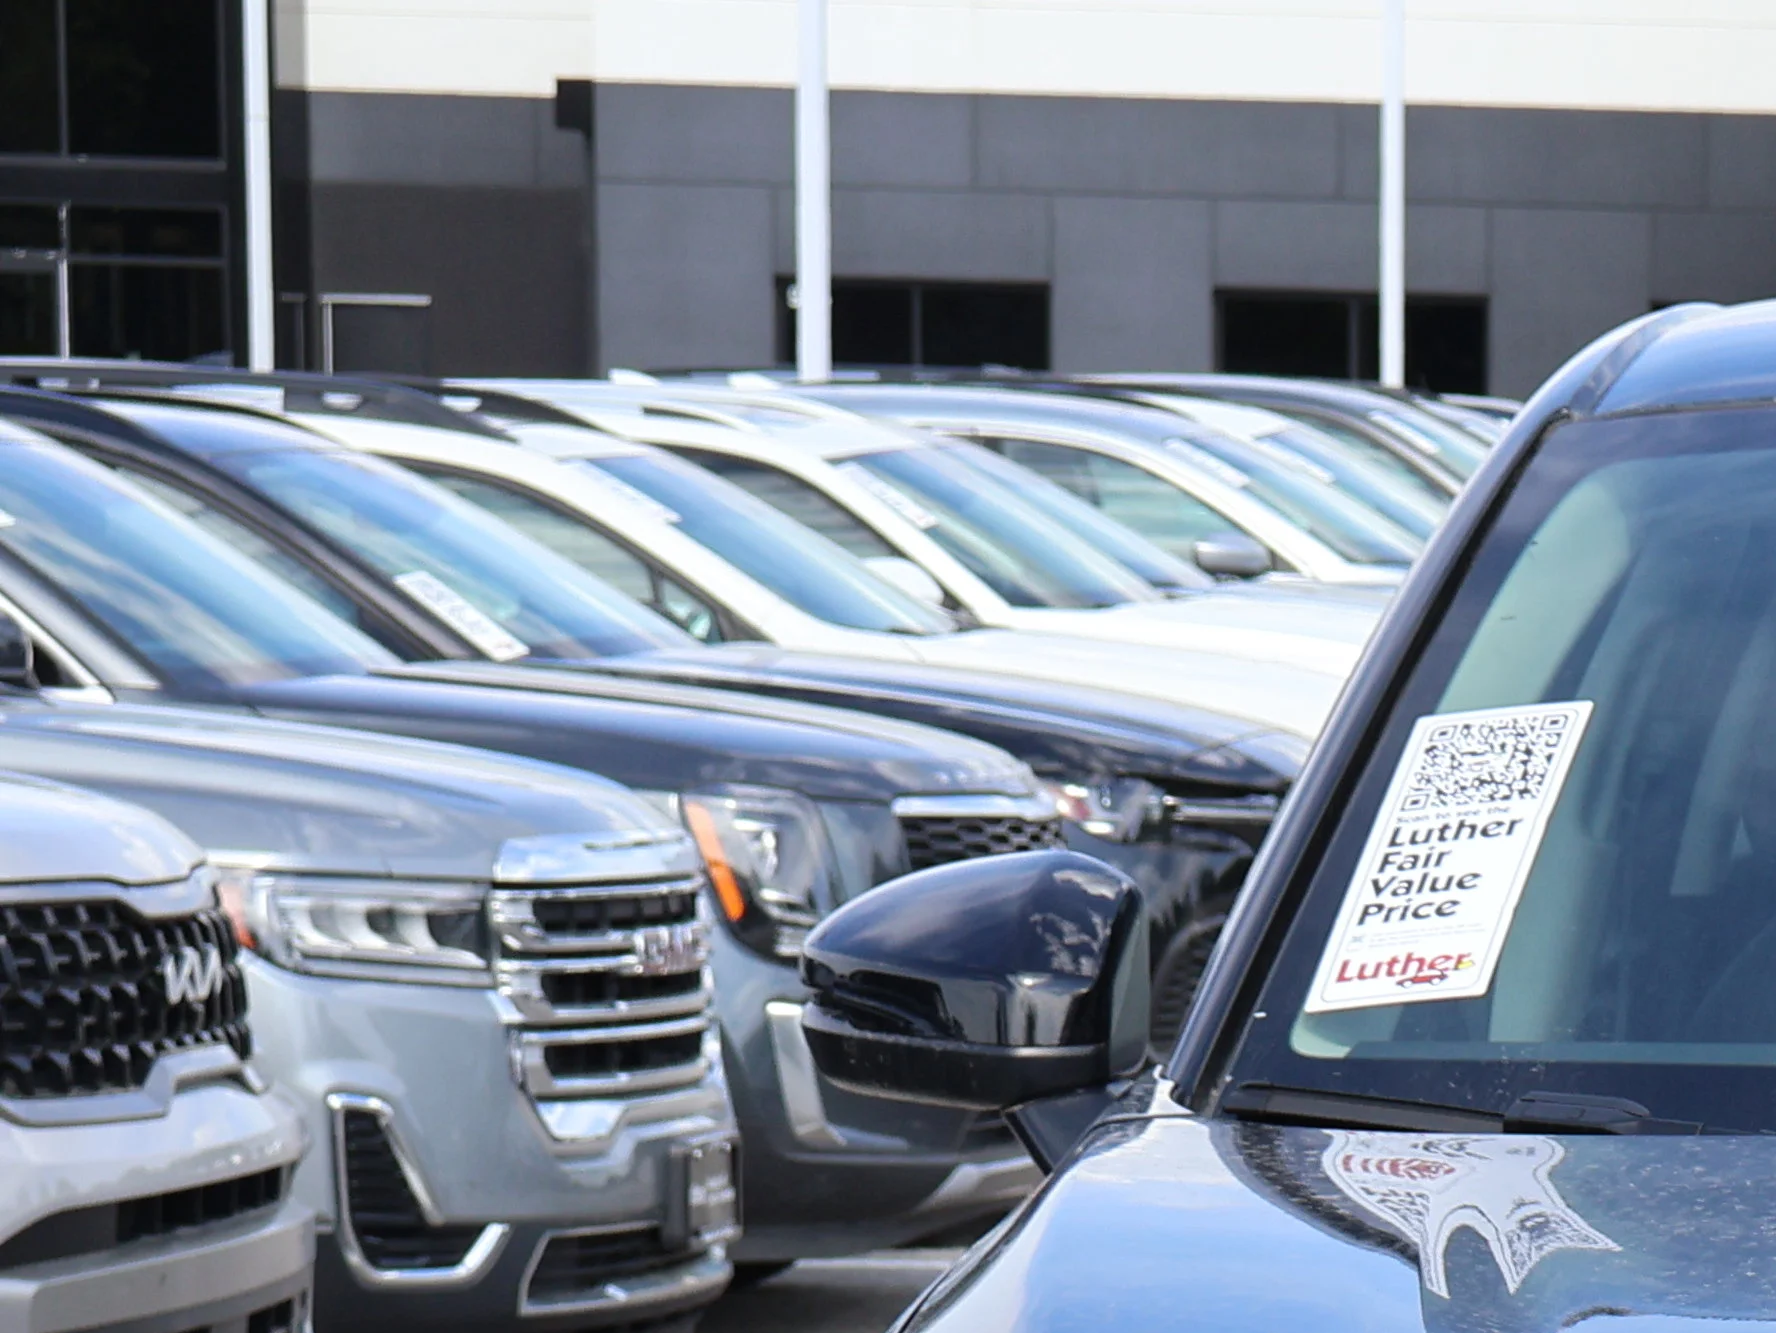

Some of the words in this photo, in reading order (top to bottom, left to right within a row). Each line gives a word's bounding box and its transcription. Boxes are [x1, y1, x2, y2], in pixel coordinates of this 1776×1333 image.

[1387, 818, 1524, 848] Luther
[1377, 845, 1452, 874] Fair
[1370, 872, 1483, 898] Value
[1356, 898, 1461, 926] Price
[1335, 952, 1472, 983] Luther
